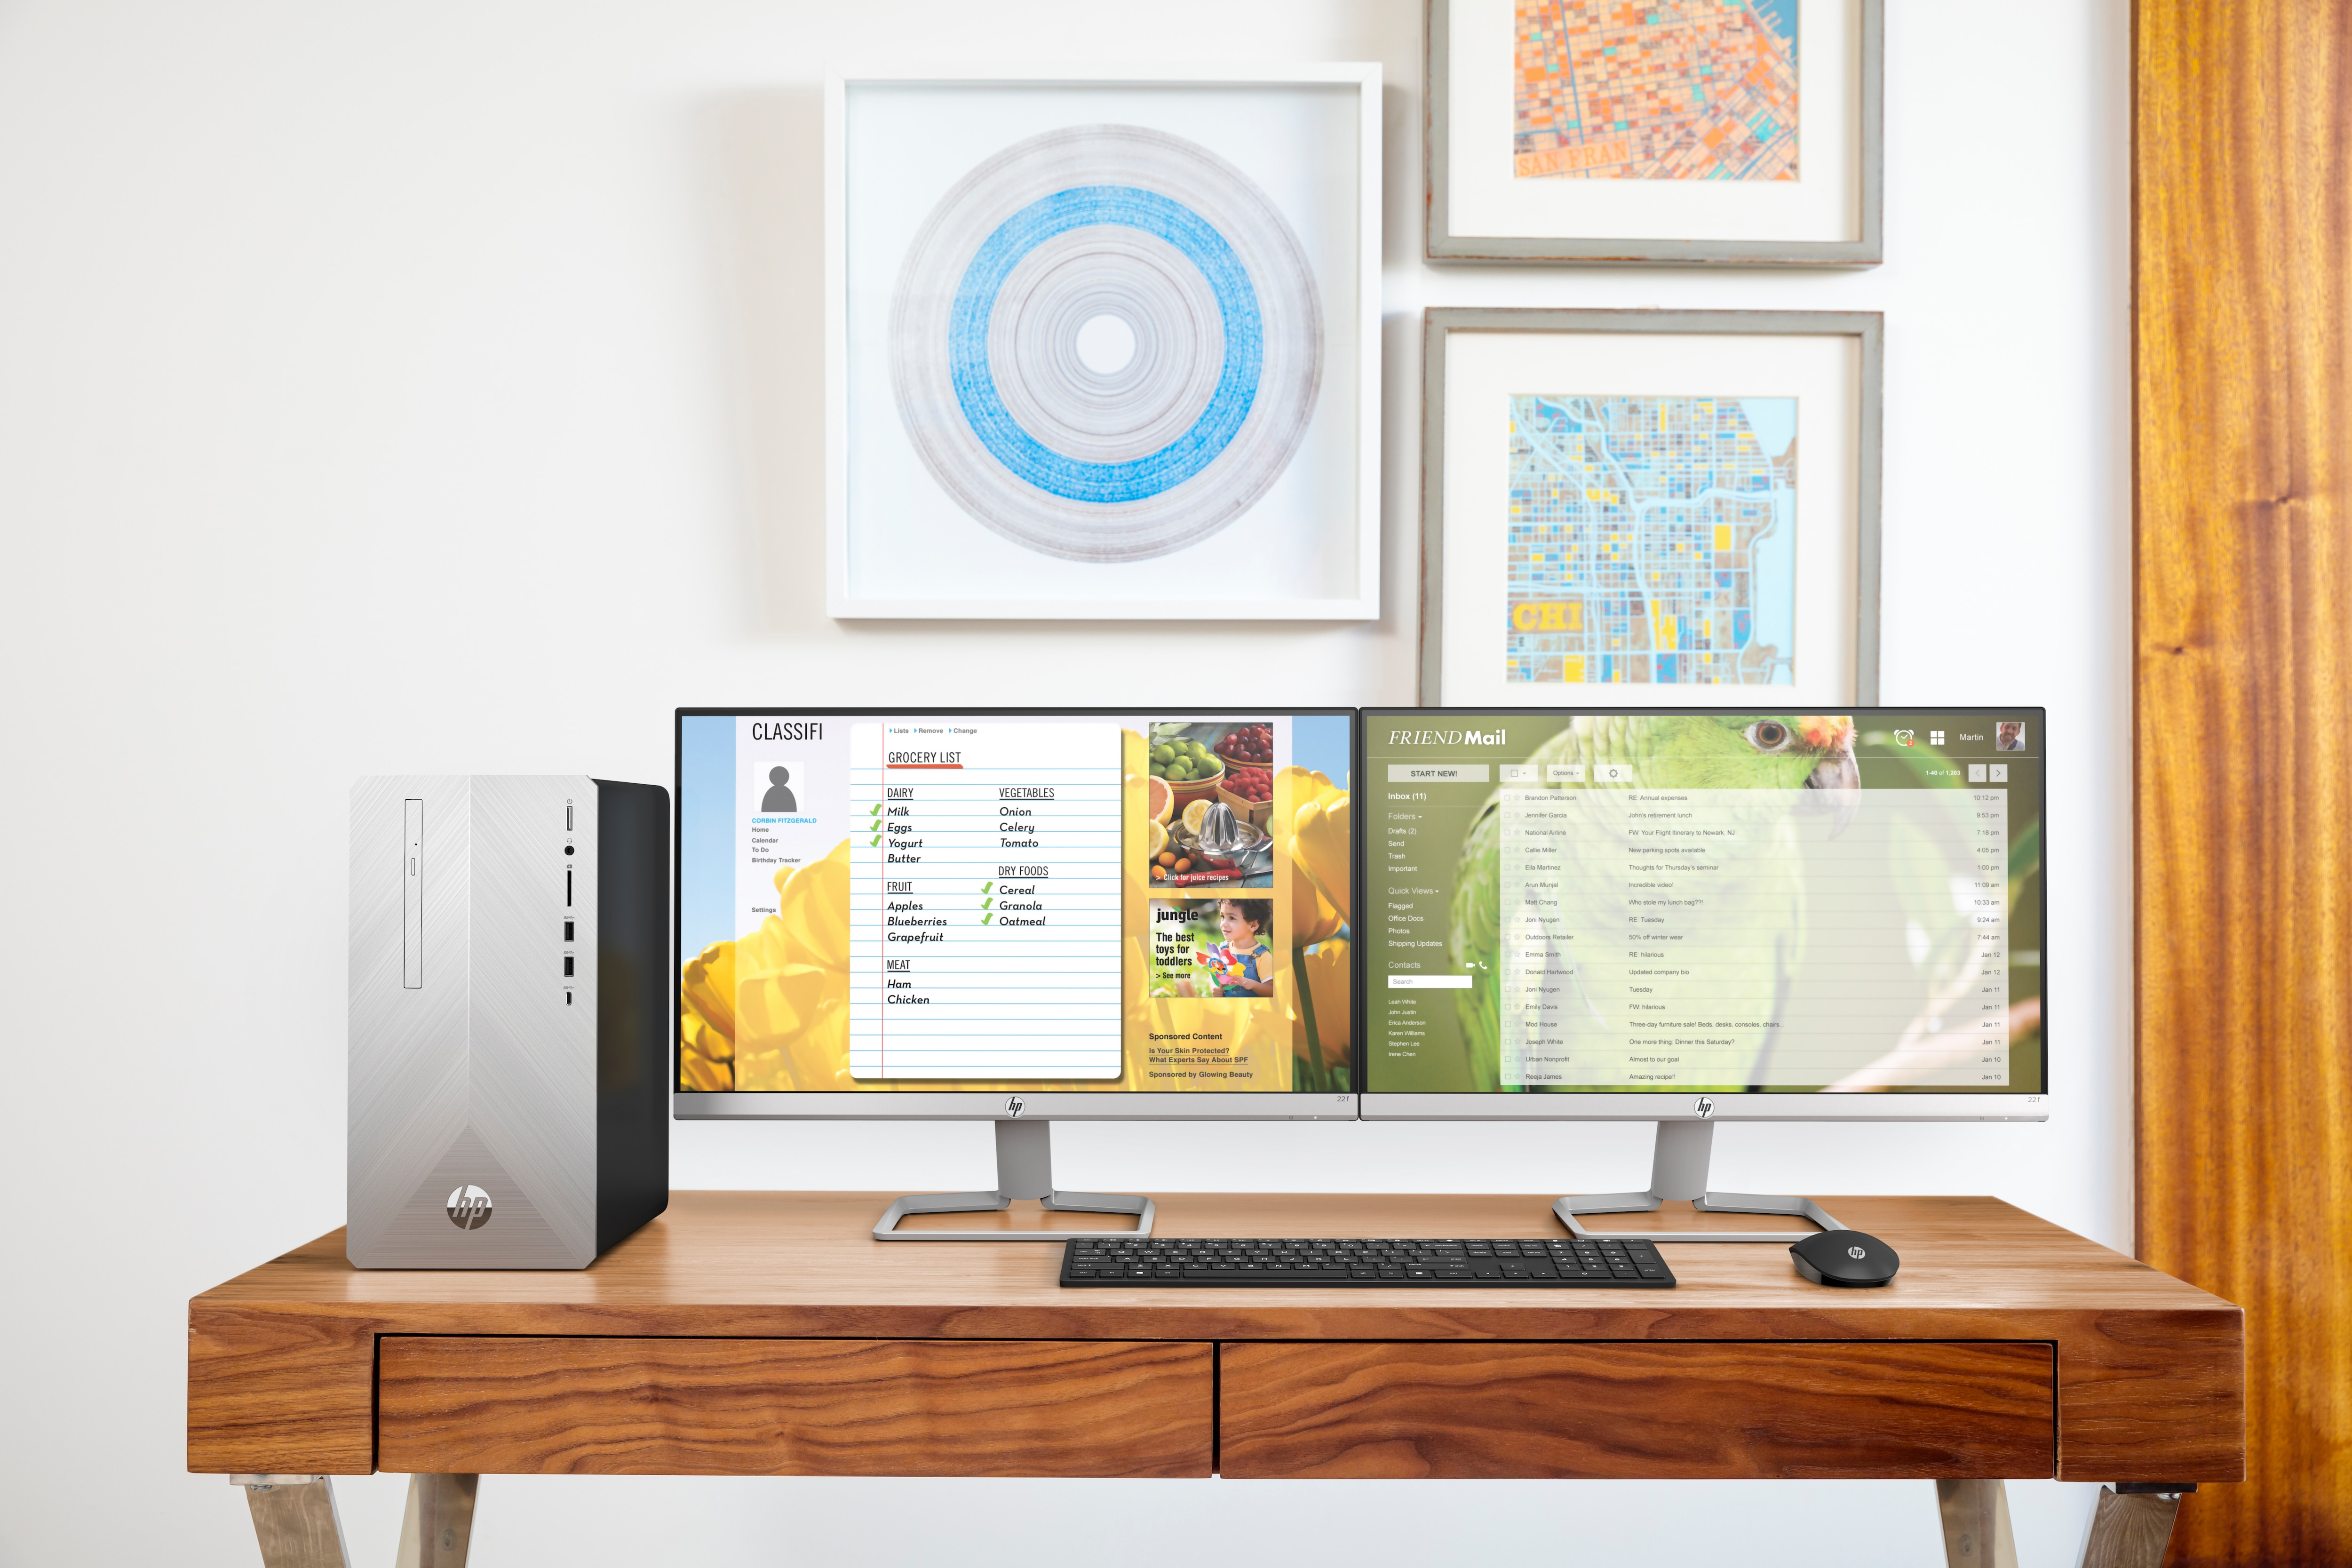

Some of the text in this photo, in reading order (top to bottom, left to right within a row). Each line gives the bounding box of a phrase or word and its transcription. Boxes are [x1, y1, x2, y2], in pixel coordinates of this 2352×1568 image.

[1518, 141, 1628, 176] SAN FRAN
[1513, 603, 1583, 630] CHI
[752, 723, 822, 740] CLASSIFI
[889, 752, 961, 763] GROCERY LIST
[887, 788, 914, 798] DAIRY
[999, 788, 1055, 798] VEGETABLES
[1412, 792, 1427, 801] (11)
[887, 806, 909, 816] Milk
[1000, 806, 1032, 816] Onion
[887, 822, 912, 835] Eggs
[1000, 822, 1035, 835] Celery
[888, 838, 923, 851] Yogurt
[1000, 838, 1039, 848] Tomato
[888, 853, 921, 863] Butter
[999, 866, 1049, 876] DRY FOODS
[1190, 874, 1205, 882] juice
[1206, 874, 1230, 883] recipes
[887, 882, 913, 891] FRUIT
[999, 884, 1035, 895] Cereal
[887, 900, 923, 913] Apples
[999, 900, 1042, 910] Granola
[887, 916, 947, 926] Blueberries
[999, 916, 1046, 926] Oatmeal
[1156, 908, 1199, 924] jungle
[888, 931, 944, 944] Grapefruit
[1155, 932, 1195, 942] The best
[1155, 944, 1190, 956] toys for
[887, 960, 910, 970] MEAT
[1155, 955, 1192, 966] toddlers
[887, 979, 911, 988] Ham
[887, 994, 930, 1004] Chicken
[1149, 1033, 1190, 1042] Sponsored
[1008, 1097, 1023, 1117] hp
[1697, 1097, 1712, 1118] hp
[451, 1185, 489, 1230] hp
[1850, 1246, 1864, 1259] hp
